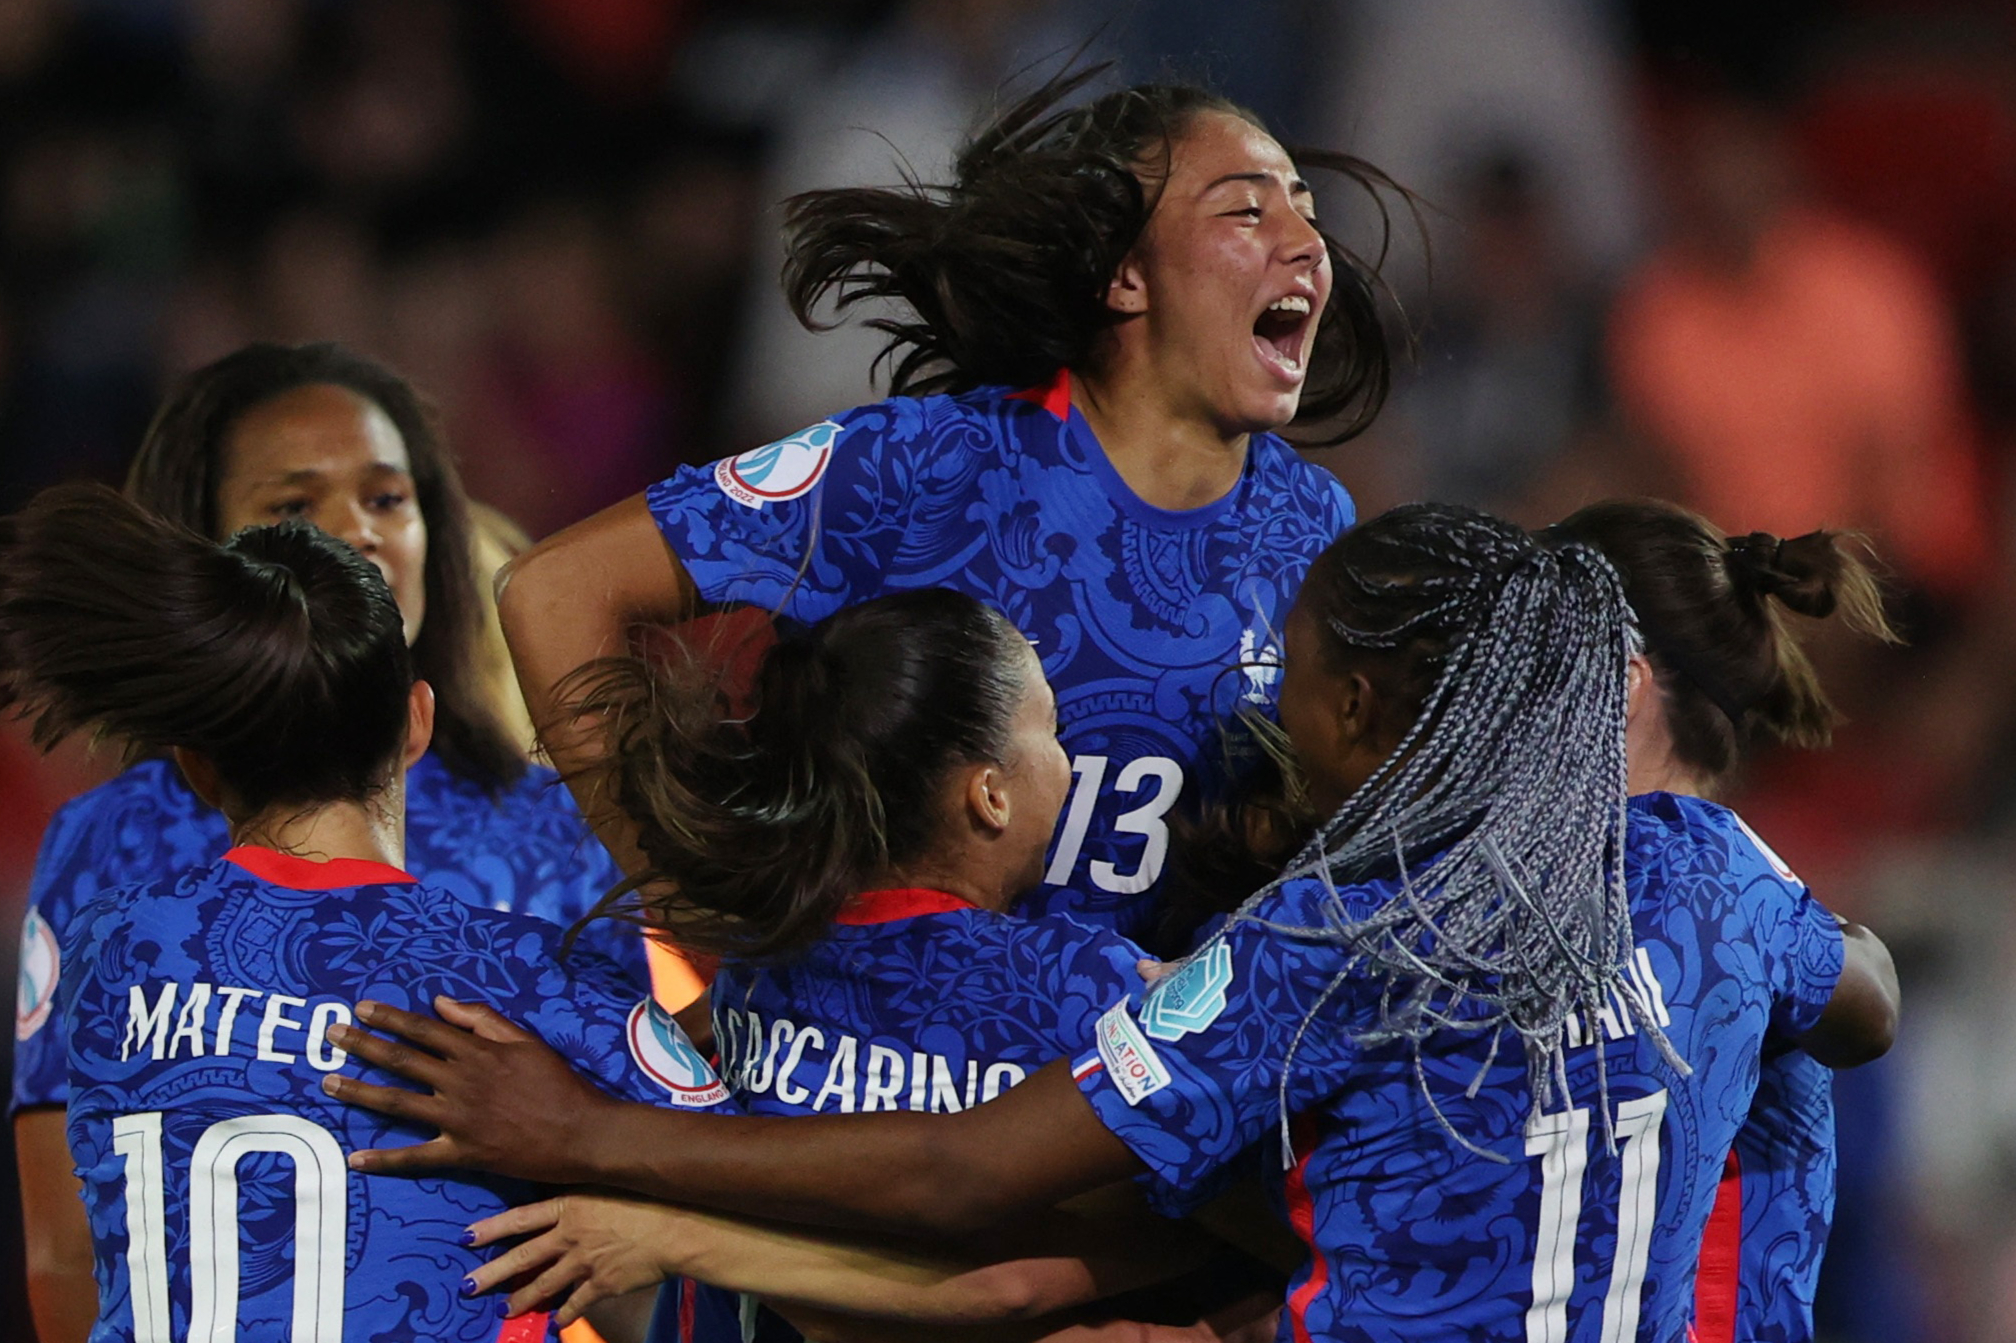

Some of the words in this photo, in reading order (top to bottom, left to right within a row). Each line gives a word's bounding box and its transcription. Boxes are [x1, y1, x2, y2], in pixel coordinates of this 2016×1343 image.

[730, 486, 755, 503] 2022
[1043, 755, 1184, 894] 13
[121, 982, 352, 1071] MATEO
[681, 1089, 724, 1103] ENGLAND
[113, 1111, 347, 1343] 10
[1525, 1088, 1668, 1343] 11
